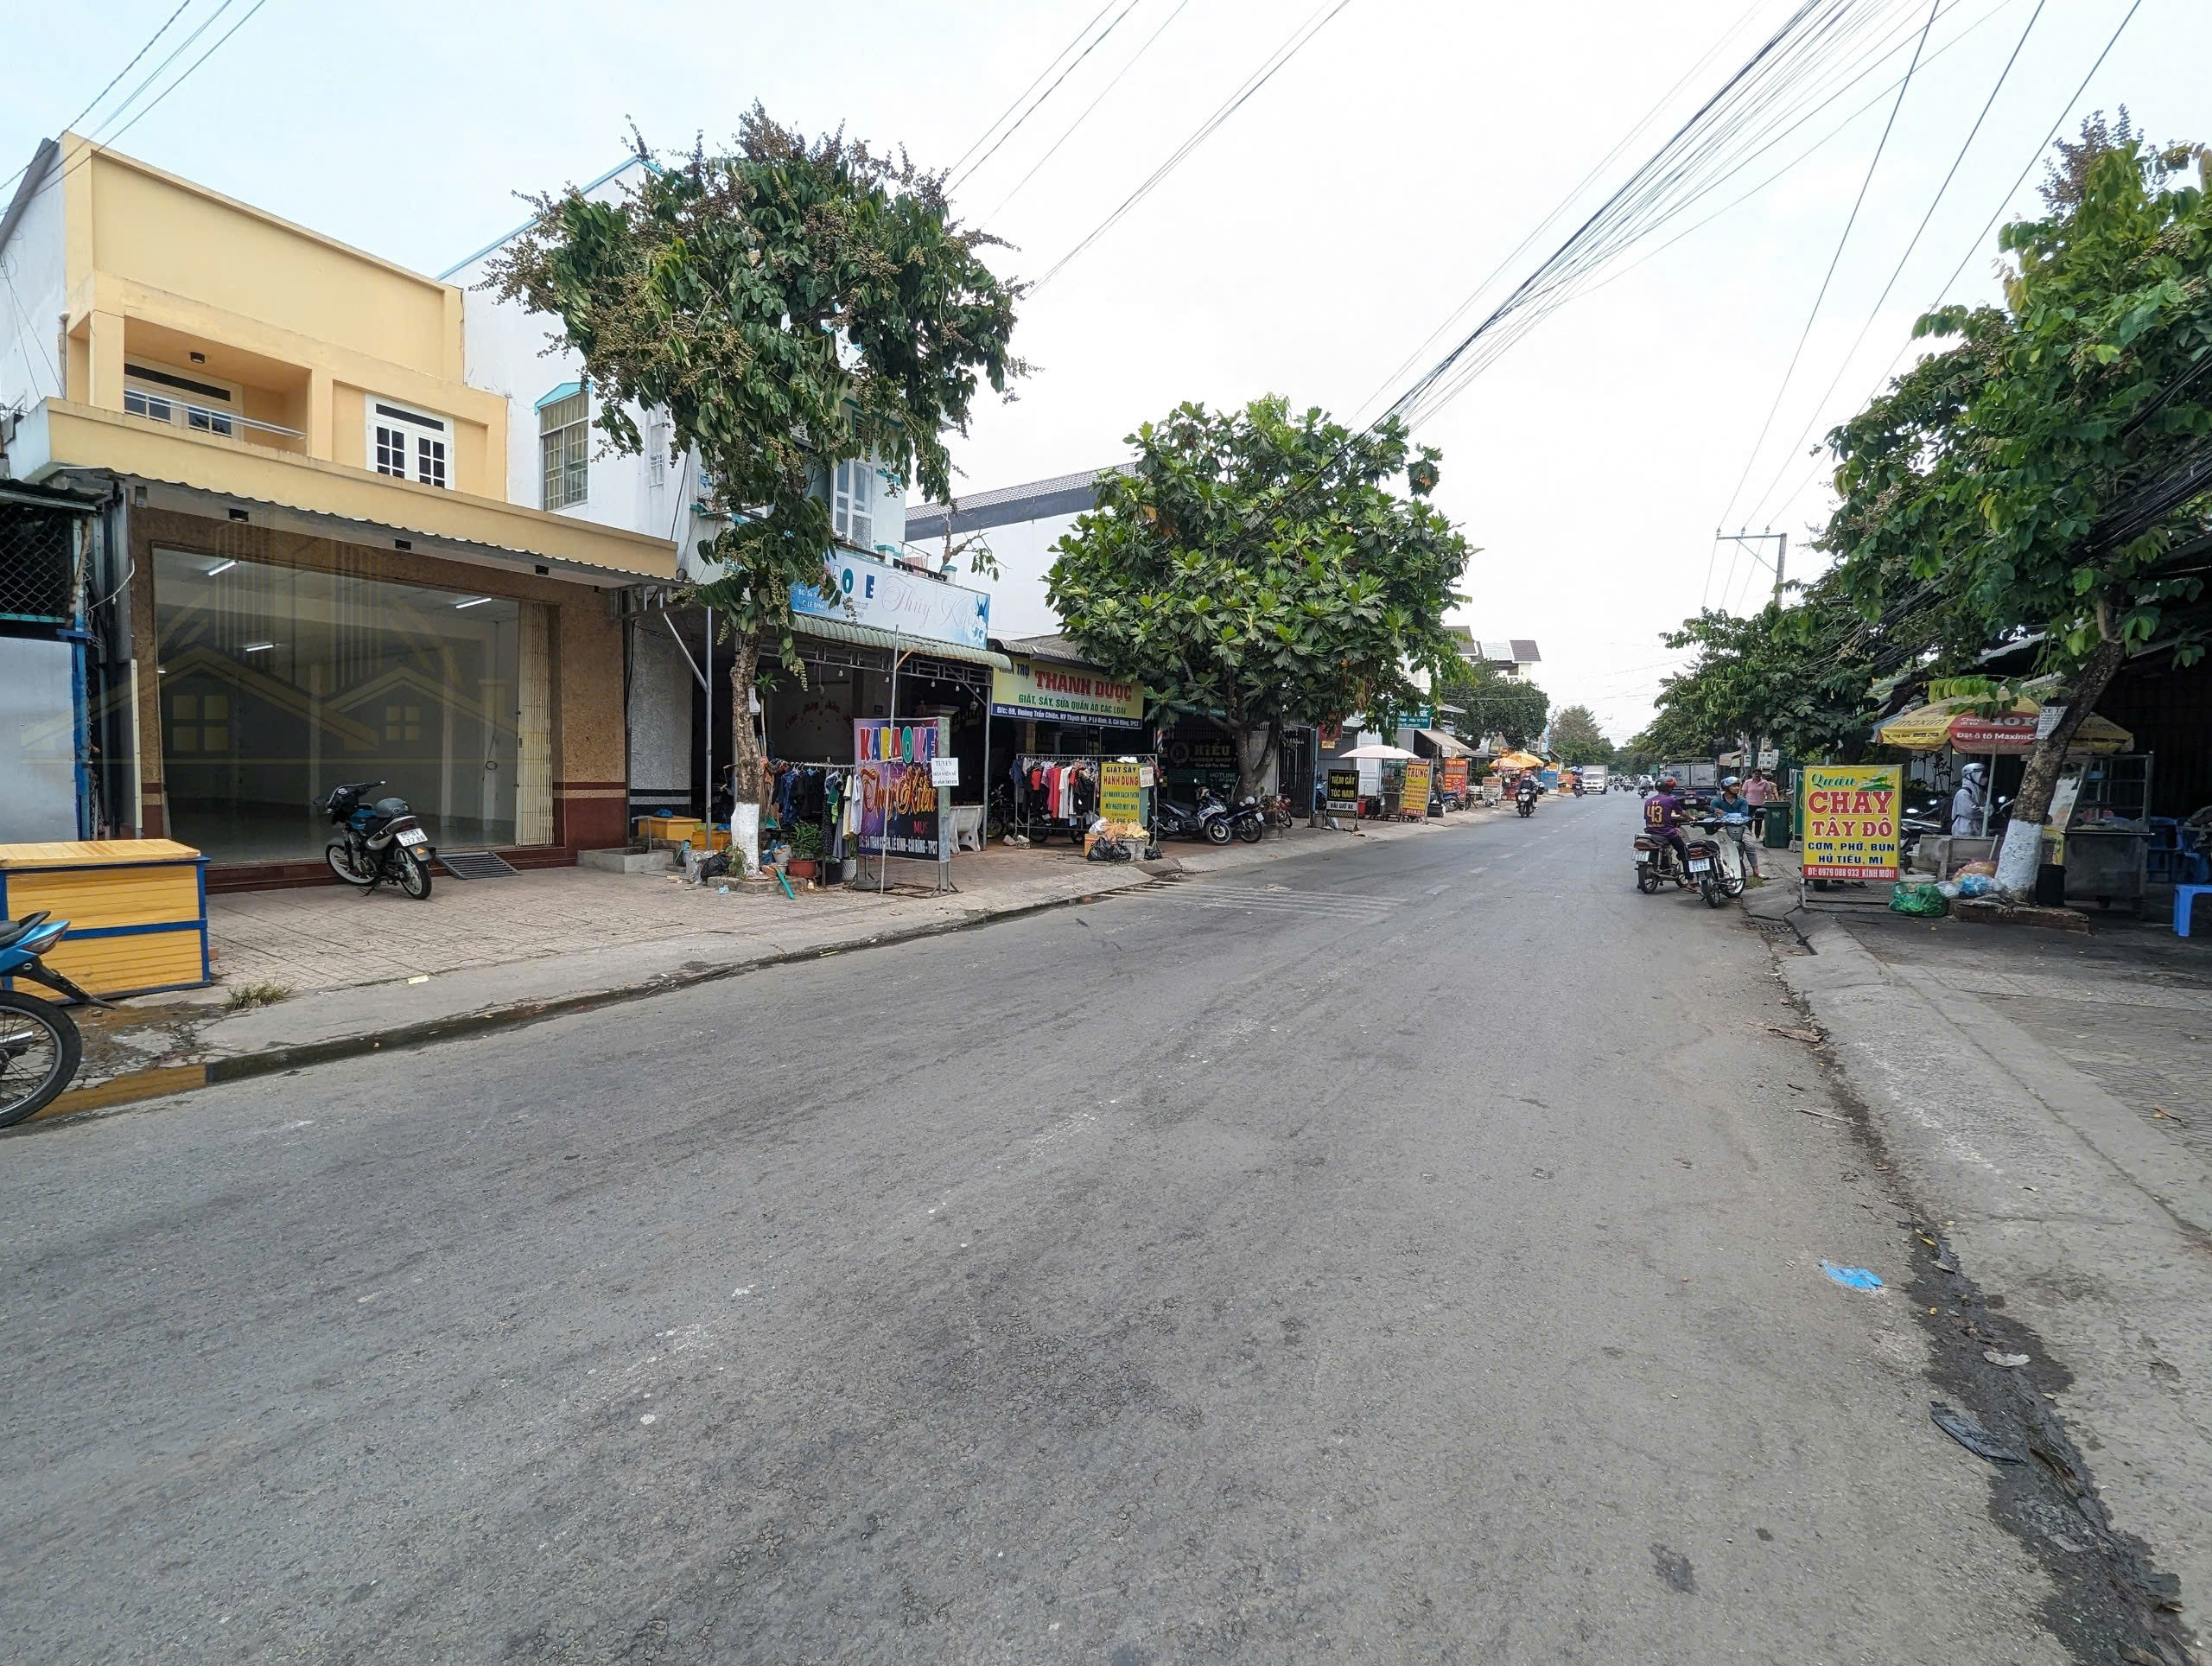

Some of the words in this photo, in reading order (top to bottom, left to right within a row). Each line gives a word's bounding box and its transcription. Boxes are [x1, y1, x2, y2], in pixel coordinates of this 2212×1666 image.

[1016, 663, 1030, 679] TRỌ
[1035, 671, 1091, 696] THÀNH
[1095, 679, 1132, 703] ĐƯỢC
[859, 725, 936, 764] KARAOKE
[1407, 766, 1428, 779] TRUNG
[1811, 773, 1854, 788] Quán
[1808, 791, 1894, 815] CHAY
[1646, 805, 1662, 823] 43
[1811, 817, 1857, 836] TÂY
[1861, 817, 1893, 837] ĐÔ
[1871, 842, 1895, 851] BÚN
[1808, 868, 1817, 876] ĐT:
[1818, 868, 1834, 877] 0979
[1834, 868, 1847, 877] 088
[1847, 868, 1859, 877] 933
